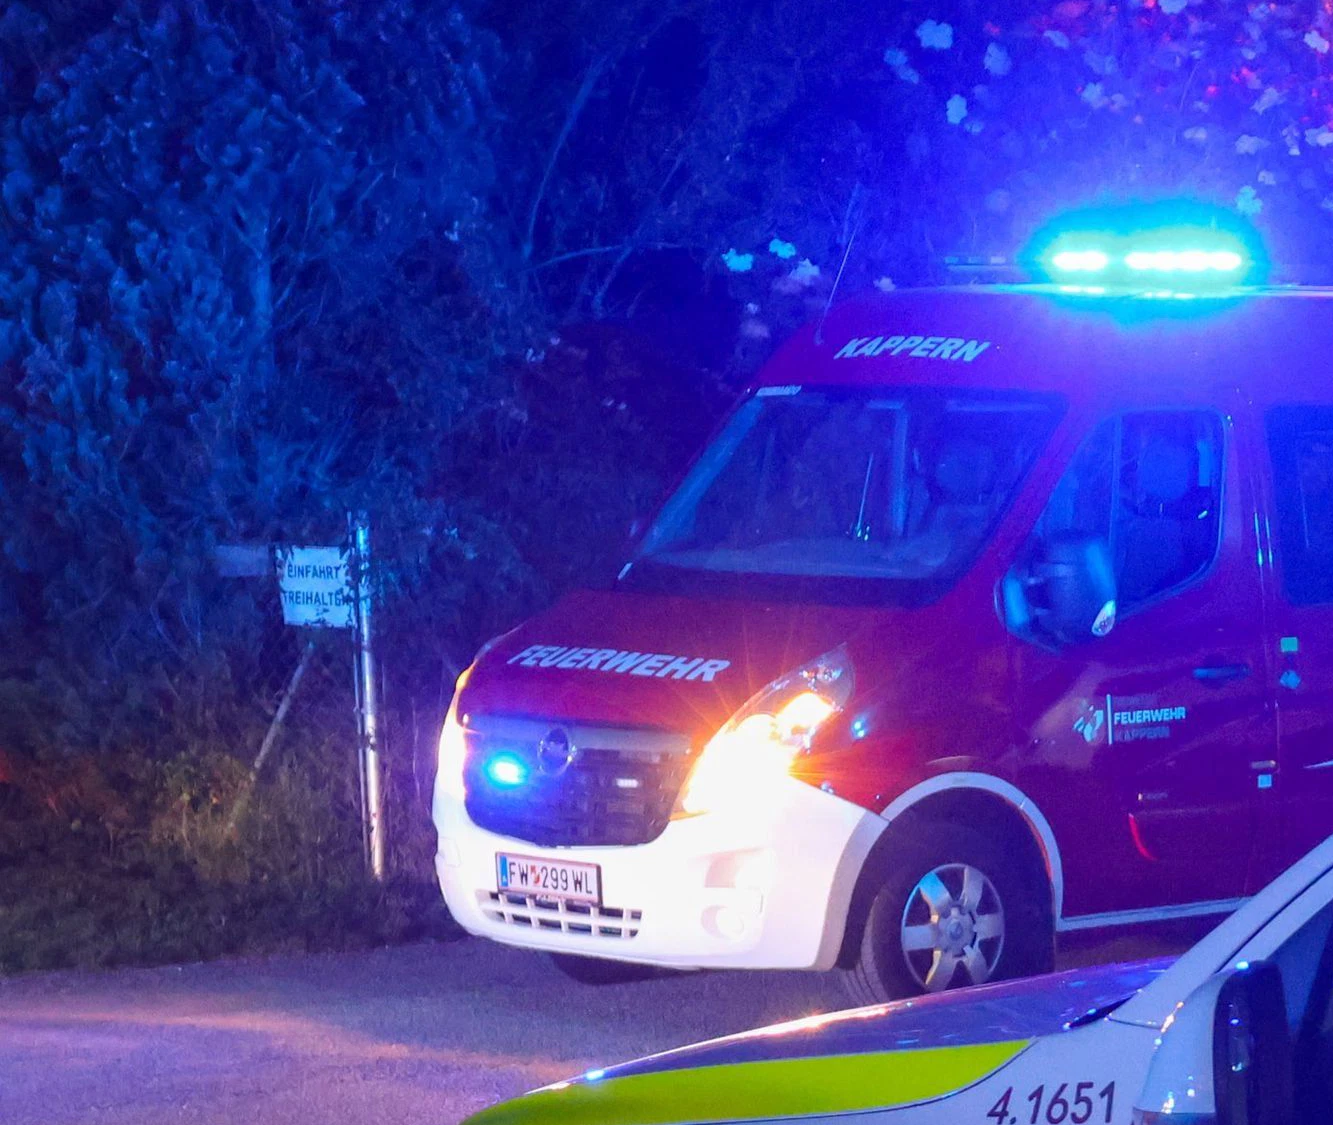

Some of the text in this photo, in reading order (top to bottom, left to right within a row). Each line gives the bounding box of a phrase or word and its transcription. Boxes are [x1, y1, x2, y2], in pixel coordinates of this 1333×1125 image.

[833, 335, 991, 362] KAPPERN
[287, 564, 341, 579] EINFAHRT
[283, 588, 349, 606] FREIHALTE
[506, 644, 731, 682] FEUERWEHR
[1114, 706, 1186, 725] FEUERWEHR
[508, 862, 593, 895] FW 299 WL
[986, 1080, 1116, 1125] 4.1651
